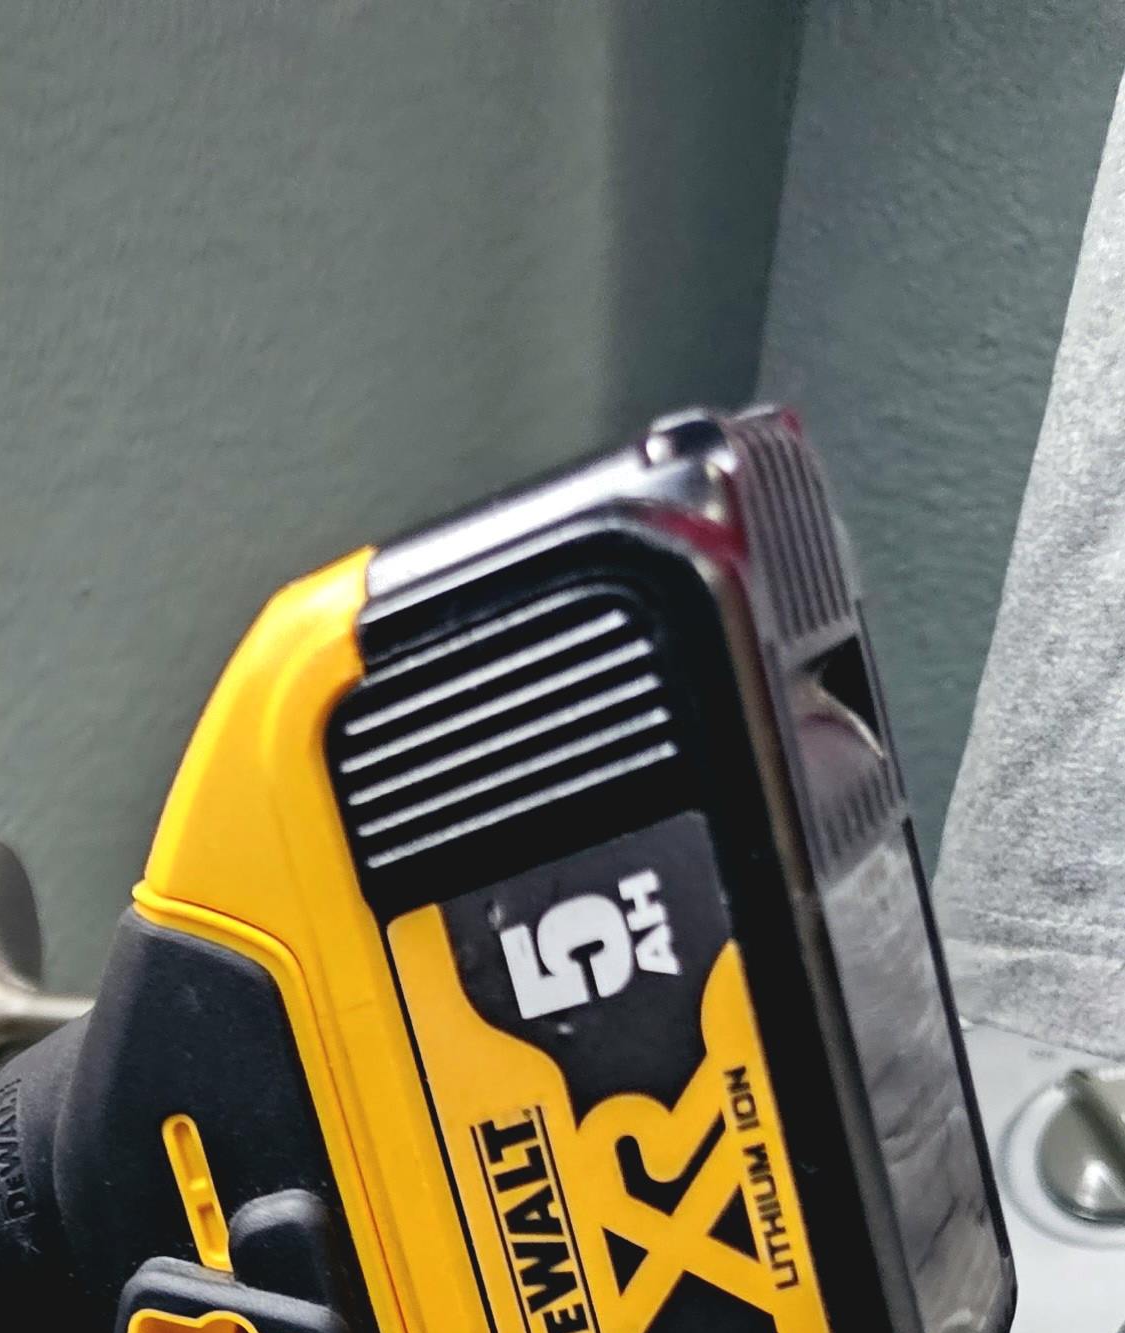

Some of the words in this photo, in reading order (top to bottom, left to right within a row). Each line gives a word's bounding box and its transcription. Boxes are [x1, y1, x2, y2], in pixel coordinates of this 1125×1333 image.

[500, 892, 633, 1020] 5
[618, 868, 681, 976] AH
[723, 1064, 762, 1132] ION
[742, 1142, 800, 1290] LITHIUM
